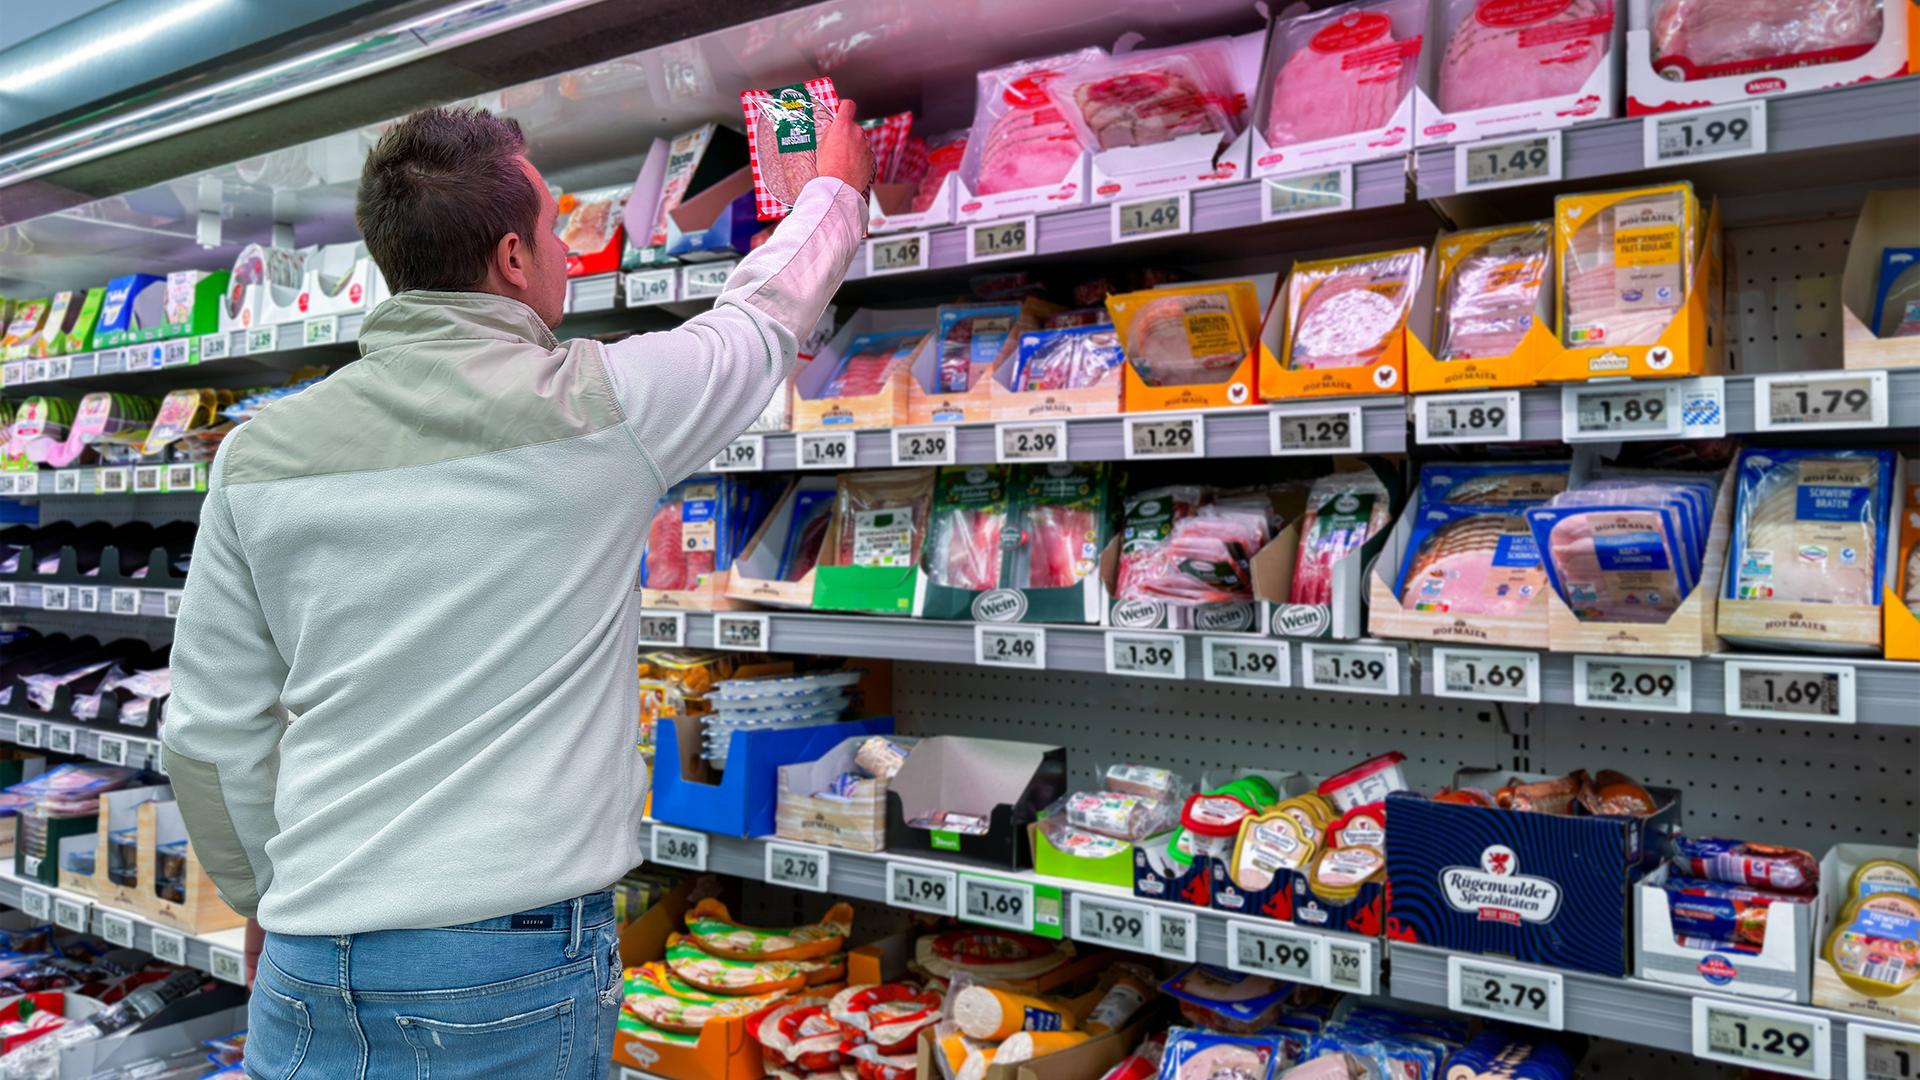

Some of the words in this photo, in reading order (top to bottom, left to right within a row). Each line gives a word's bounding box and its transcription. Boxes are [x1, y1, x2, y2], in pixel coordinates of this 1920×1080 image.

[1681, 118, 1748, 148] 1.99
[1488, 149, 1547, 175] 1.49
[1135, 206, 1179, 229] 1.49
[987, 229, 1026, 250] 1.49
[885, 245, 919, 264] 1.49
[641, 280, 668, 296] 1.49
[1601, 398, 1664, 422] 1.89
[1795, 389, 1869, 415] 1.79
[1447, 407, 1505, 430] 1.89
[1018, 433, 1057, 451] 2.39
[1148, 428, 1193, 449] 1.29
[1297, 421, 1349, 442] 1.29
[726, 446, 754, 463] 1.99
[814, 442, 846, 460] 1.49
[911, 438, 946, 456] 2.39
[1809, 487, 1856, 498] SCHWEINE-
[1815, 498, 1849, 509] BRATEN
[979, 597, 1019, 618] Wein
[1119, 604, 1155, 623] Wein
[649, 621, 676, 637] 1.99
[1204, 609, 1242, 628] Wein
[1281, 611, 1319, 632] Wein
[1765, 619, 1827, 632] HOFMAIER
[1433, 626, 1488, 640] HOFMAIER
[996, 639, 1035, 658] 2.49
[1129, 646, 1173, 667] 1.39
[1229, 651, 1278, 673] 1.39
[1331, 657, 1384, 681] 1.39
[1466, 664, 1525, 688] 1.69
[1610, 671, 1675, 697] 2.09
[1764, 679, 1821, 705] 1.69
[667, 839, 698, 860] 3.89
[784, 858, 819, 879] 2.79
[906, 877, 946, 901] 1.99
[1450, 871, 1551, 901] Rügenwalder
[980, 891, 1022, 915] 1.69
[1459, 888, 1540, 911] Spezialitäten
[1096, 911, 1142, 938] 1.99
[1161, 922, 1186, 937] 1.99
[1869, 912, 1910, 926] TEEWURST
[1256, 940, 1309, 968] 1.99
[1332, 954, 1360, 969] 1.99
[1484, 979, 1546, 1010] 2.79
[1734, 1022, 1811, 1058] 1.29
